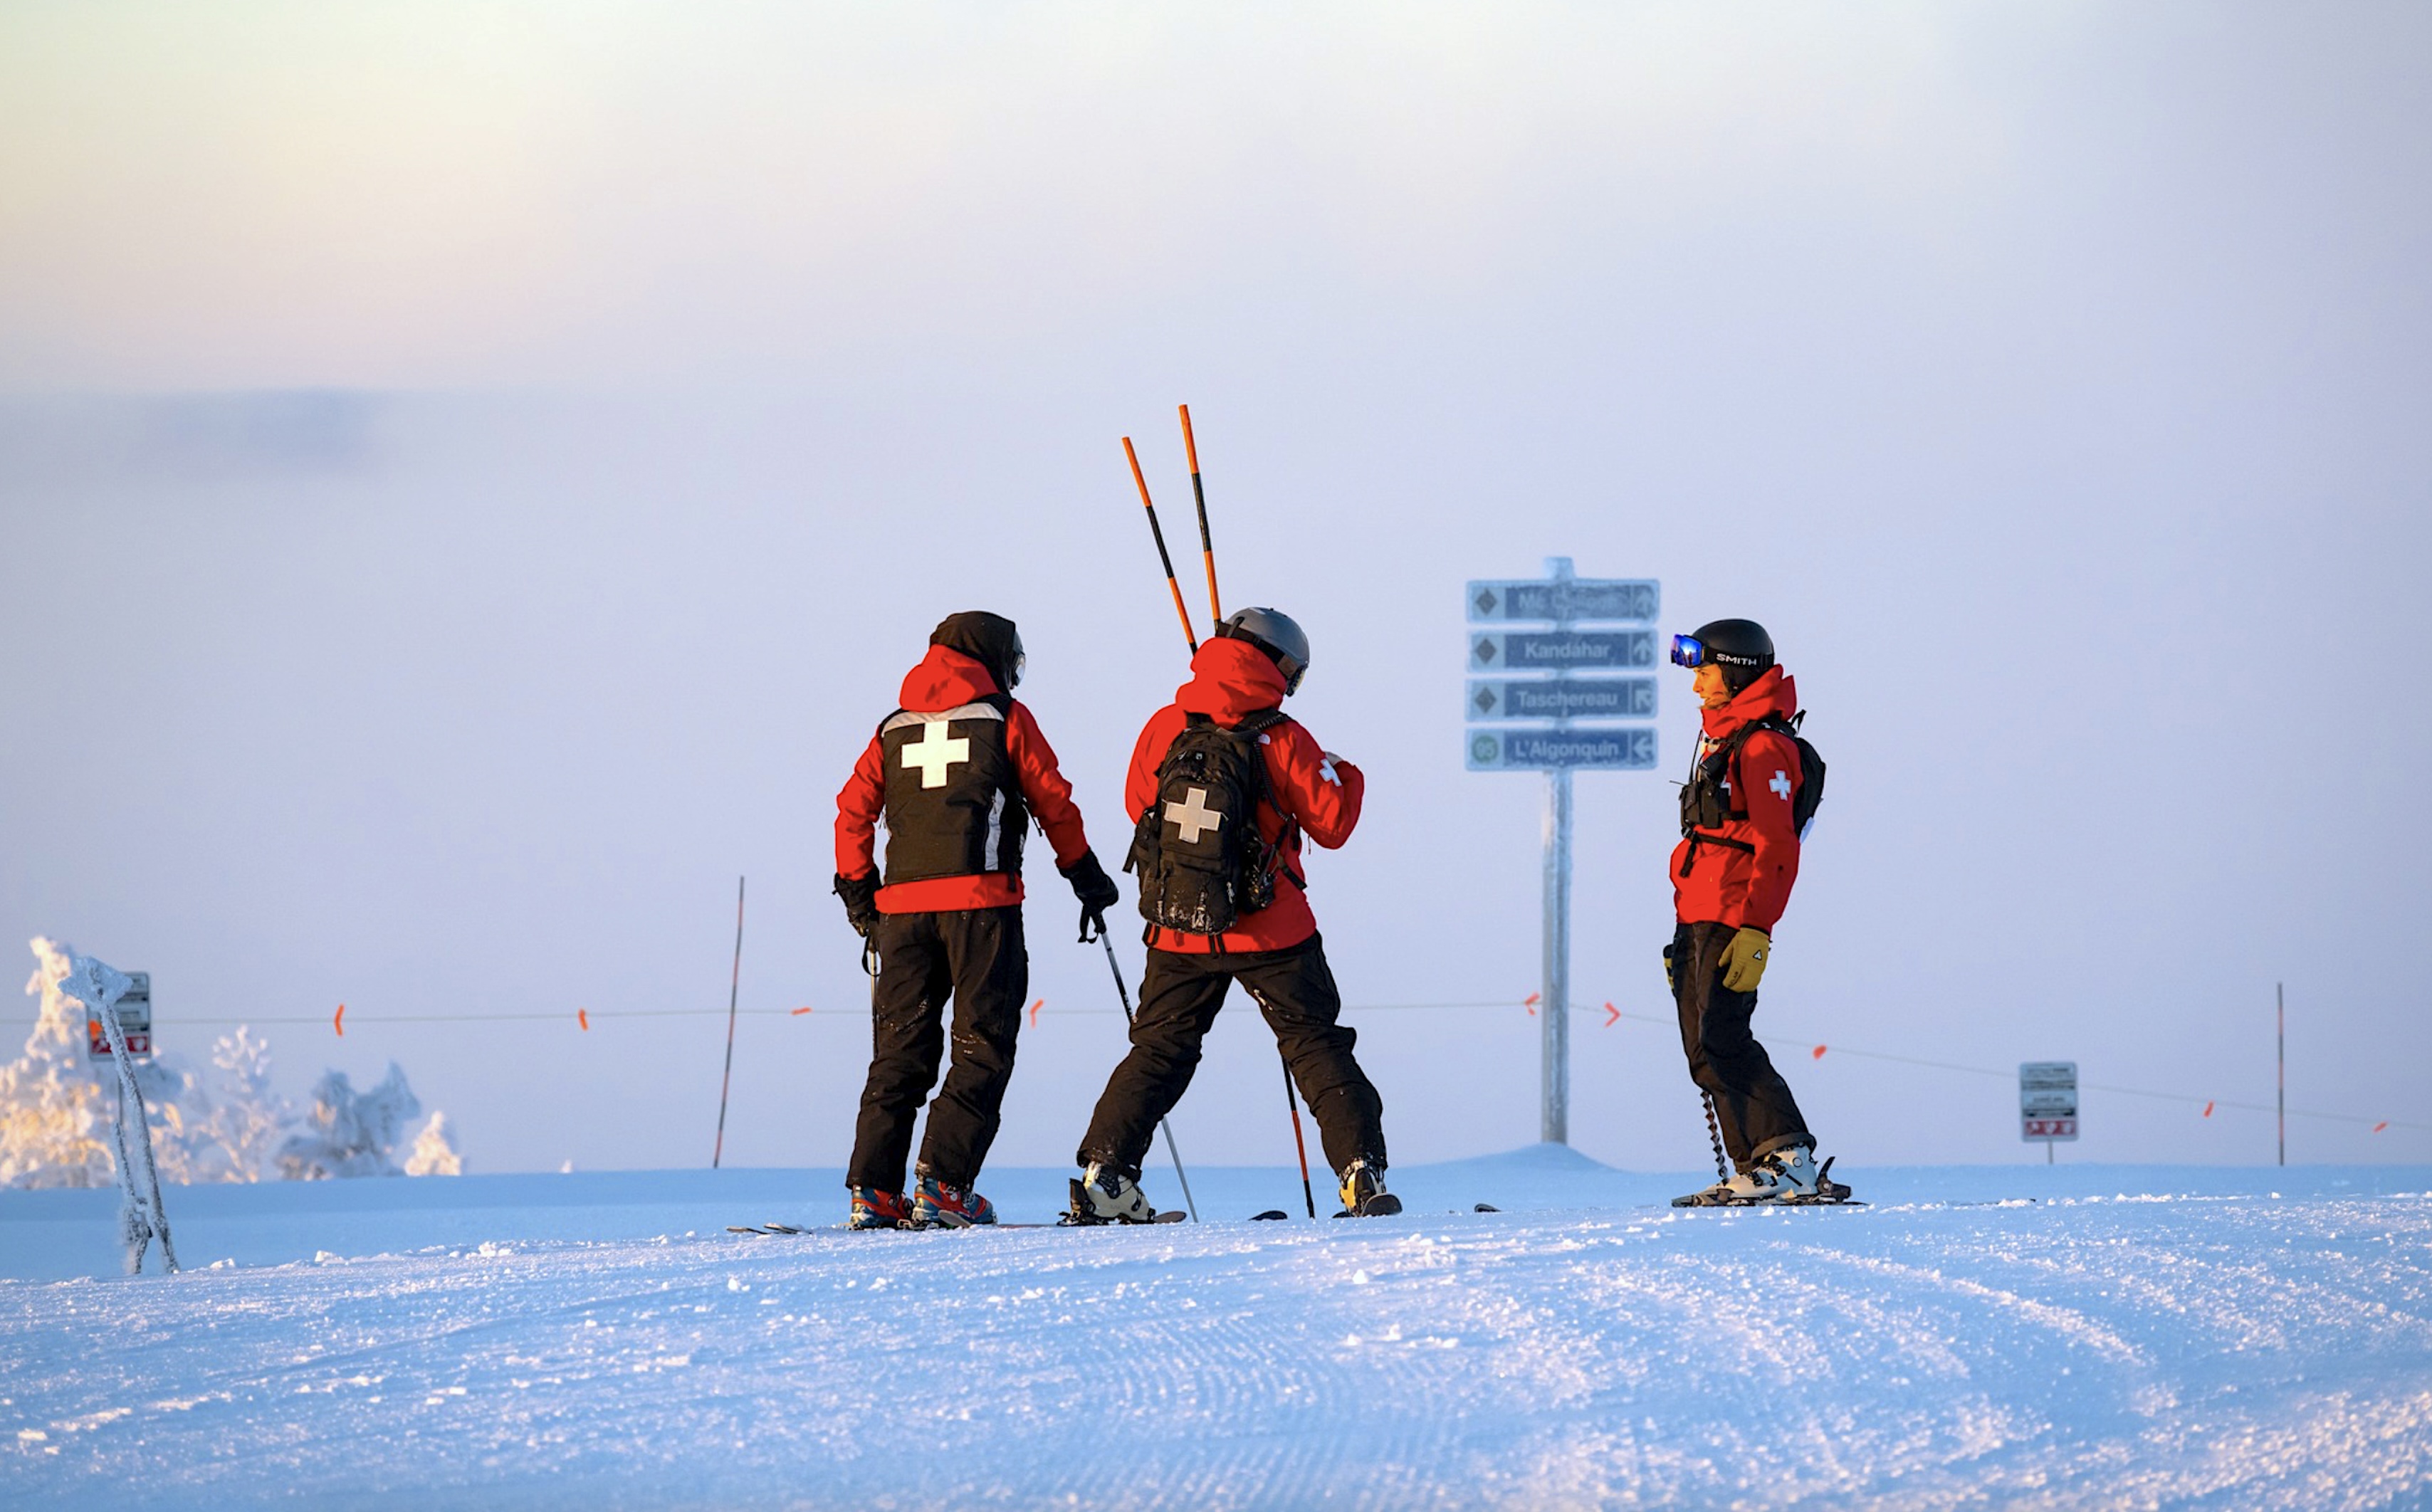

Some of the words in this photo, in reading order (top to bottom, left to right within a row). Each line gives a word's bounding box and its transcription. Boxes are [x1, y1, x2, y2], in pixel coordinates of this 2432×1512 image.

[1525, 643, 1610, 658] Kandahar
[1716, 653, 1757, 666] SMITH
[1517, 691, 1618, 707] Taschereau
[1515, 740, 1619, 760] L'Algonquin
